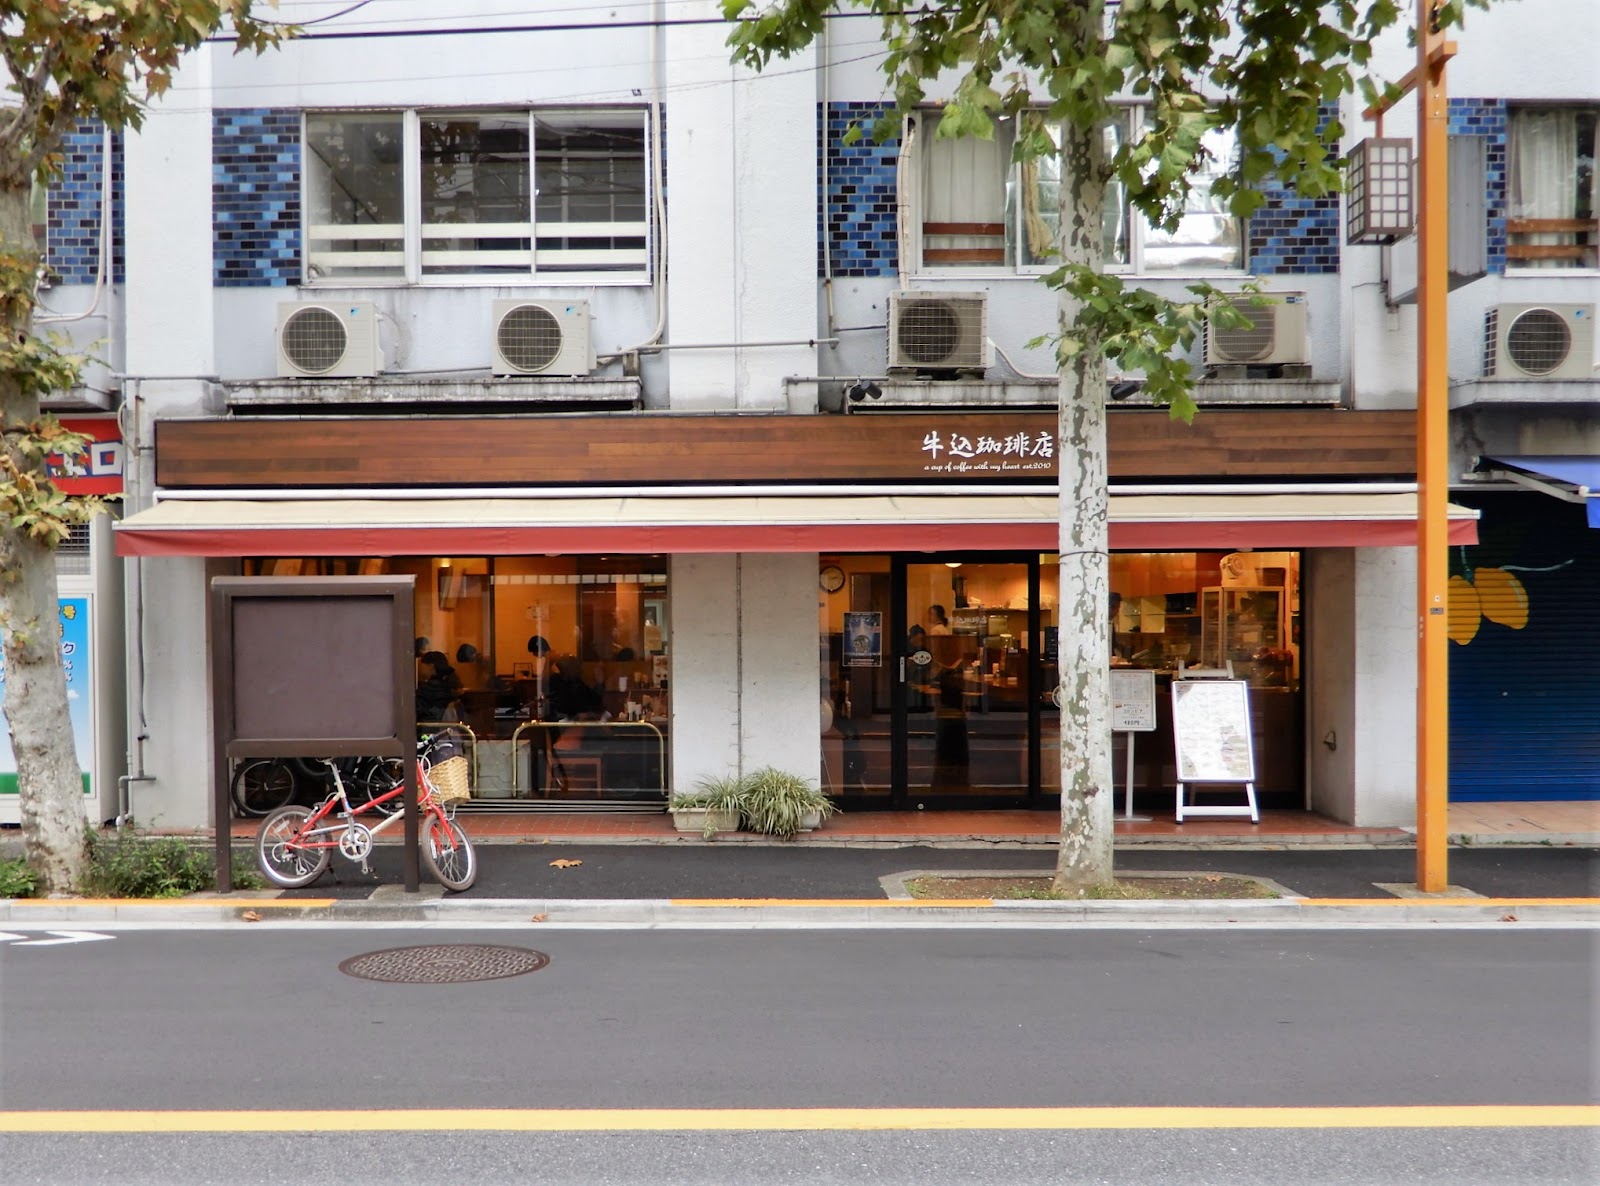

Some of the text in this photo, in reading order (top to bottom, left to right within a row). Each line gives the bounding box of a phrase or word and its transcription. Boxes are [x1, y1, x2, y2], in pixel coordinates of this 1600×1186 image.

[922, 431, 1053, 459] 牛込珈琲店
[944, 461, 952, 472] of
[953, 461, 972, 472] coffee
[974, 461, 988, 470] with
[990, 464, 1001, 472] my
[1002, 461, 1020, 470] heart
